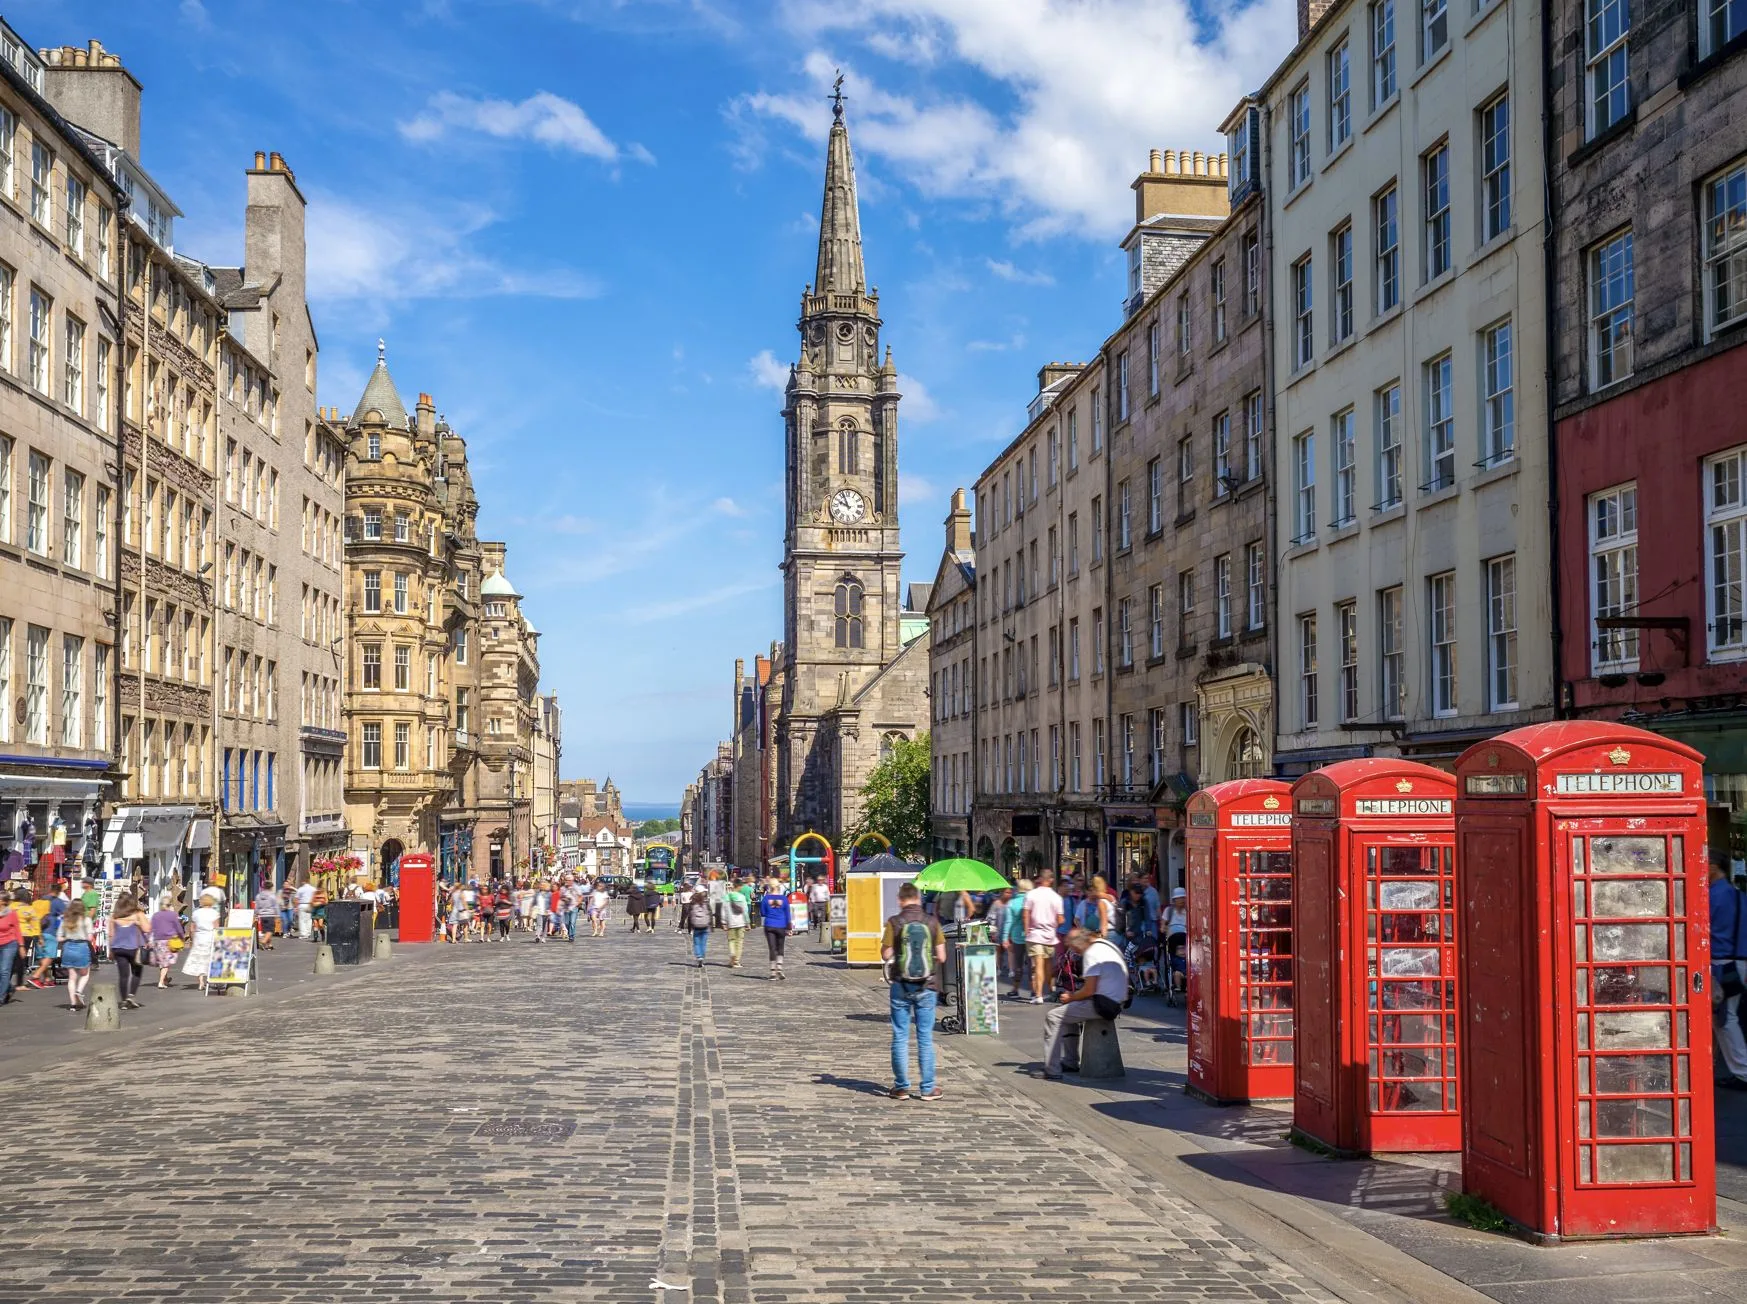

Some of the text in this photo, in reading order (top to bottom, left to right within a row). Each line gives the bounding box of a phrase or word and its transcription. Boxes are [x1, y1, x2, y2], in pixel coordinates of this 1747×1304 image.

[1561, 774, 1678, 792] TELEPHONE
[1360, 800, 1449, 813] TELEPHONE
[1234, 814, 1291, 825] TELEPHO
